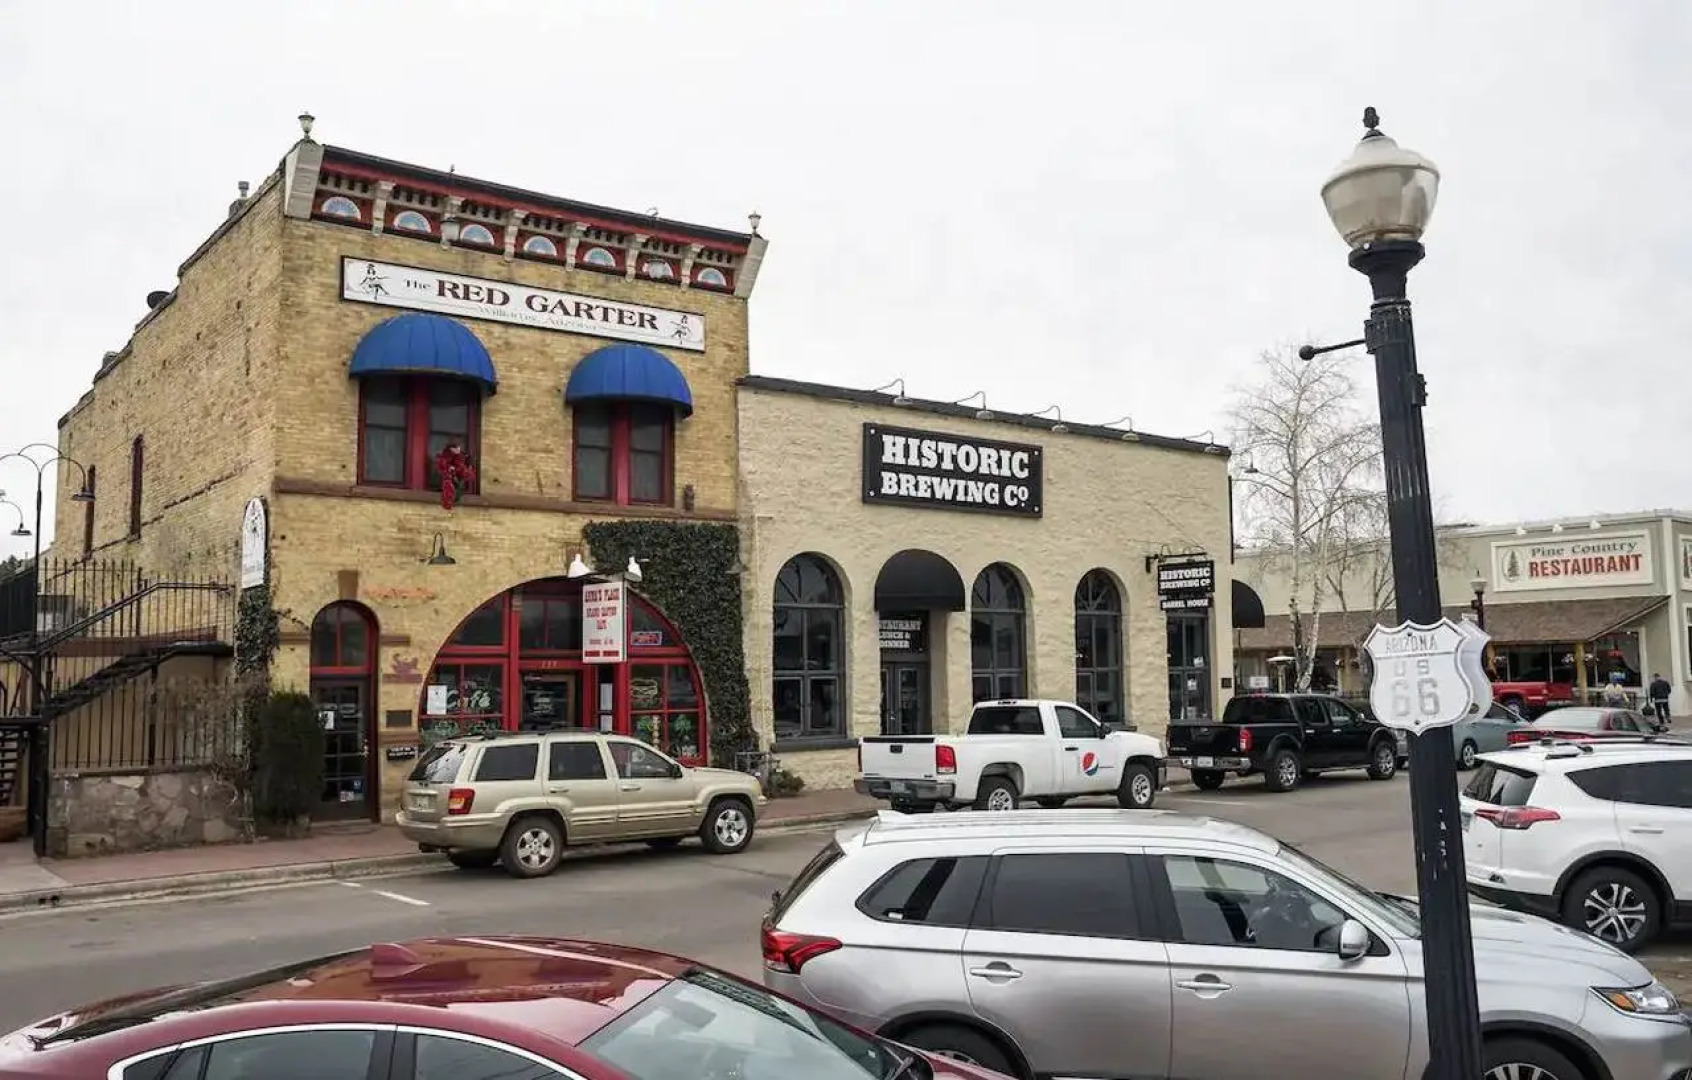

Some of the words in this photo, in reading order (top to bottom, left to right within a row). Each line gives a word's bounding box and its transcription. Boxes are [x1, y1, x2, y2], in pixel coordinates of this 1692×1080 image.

[404, 277, 432, 290] The
[436, 279, 510, 306] RED
[525, 294, 658, 330] GARTER
[881, 434, 1029, 479] HISTORIC
[880, 471, 999, 505] BREWING
[1531, 546, 1565, 558] Pine
[1571, 540, 1637, 554] Country
[1160, 567, 1211, 580] HISTORIC
[1529, 553, 1642, 578] RESTAURANT
[1160, 579, 1199, 589] BREWING
[1162, 600, 1186, 609] BARREL
[1186, 598, 1209, 608] HOUSE
[879, 619, 922, 630] STAURANT
[1386, 633, 1438, 654] ARIZONA
[1391, 678, 1440, 718] 66
